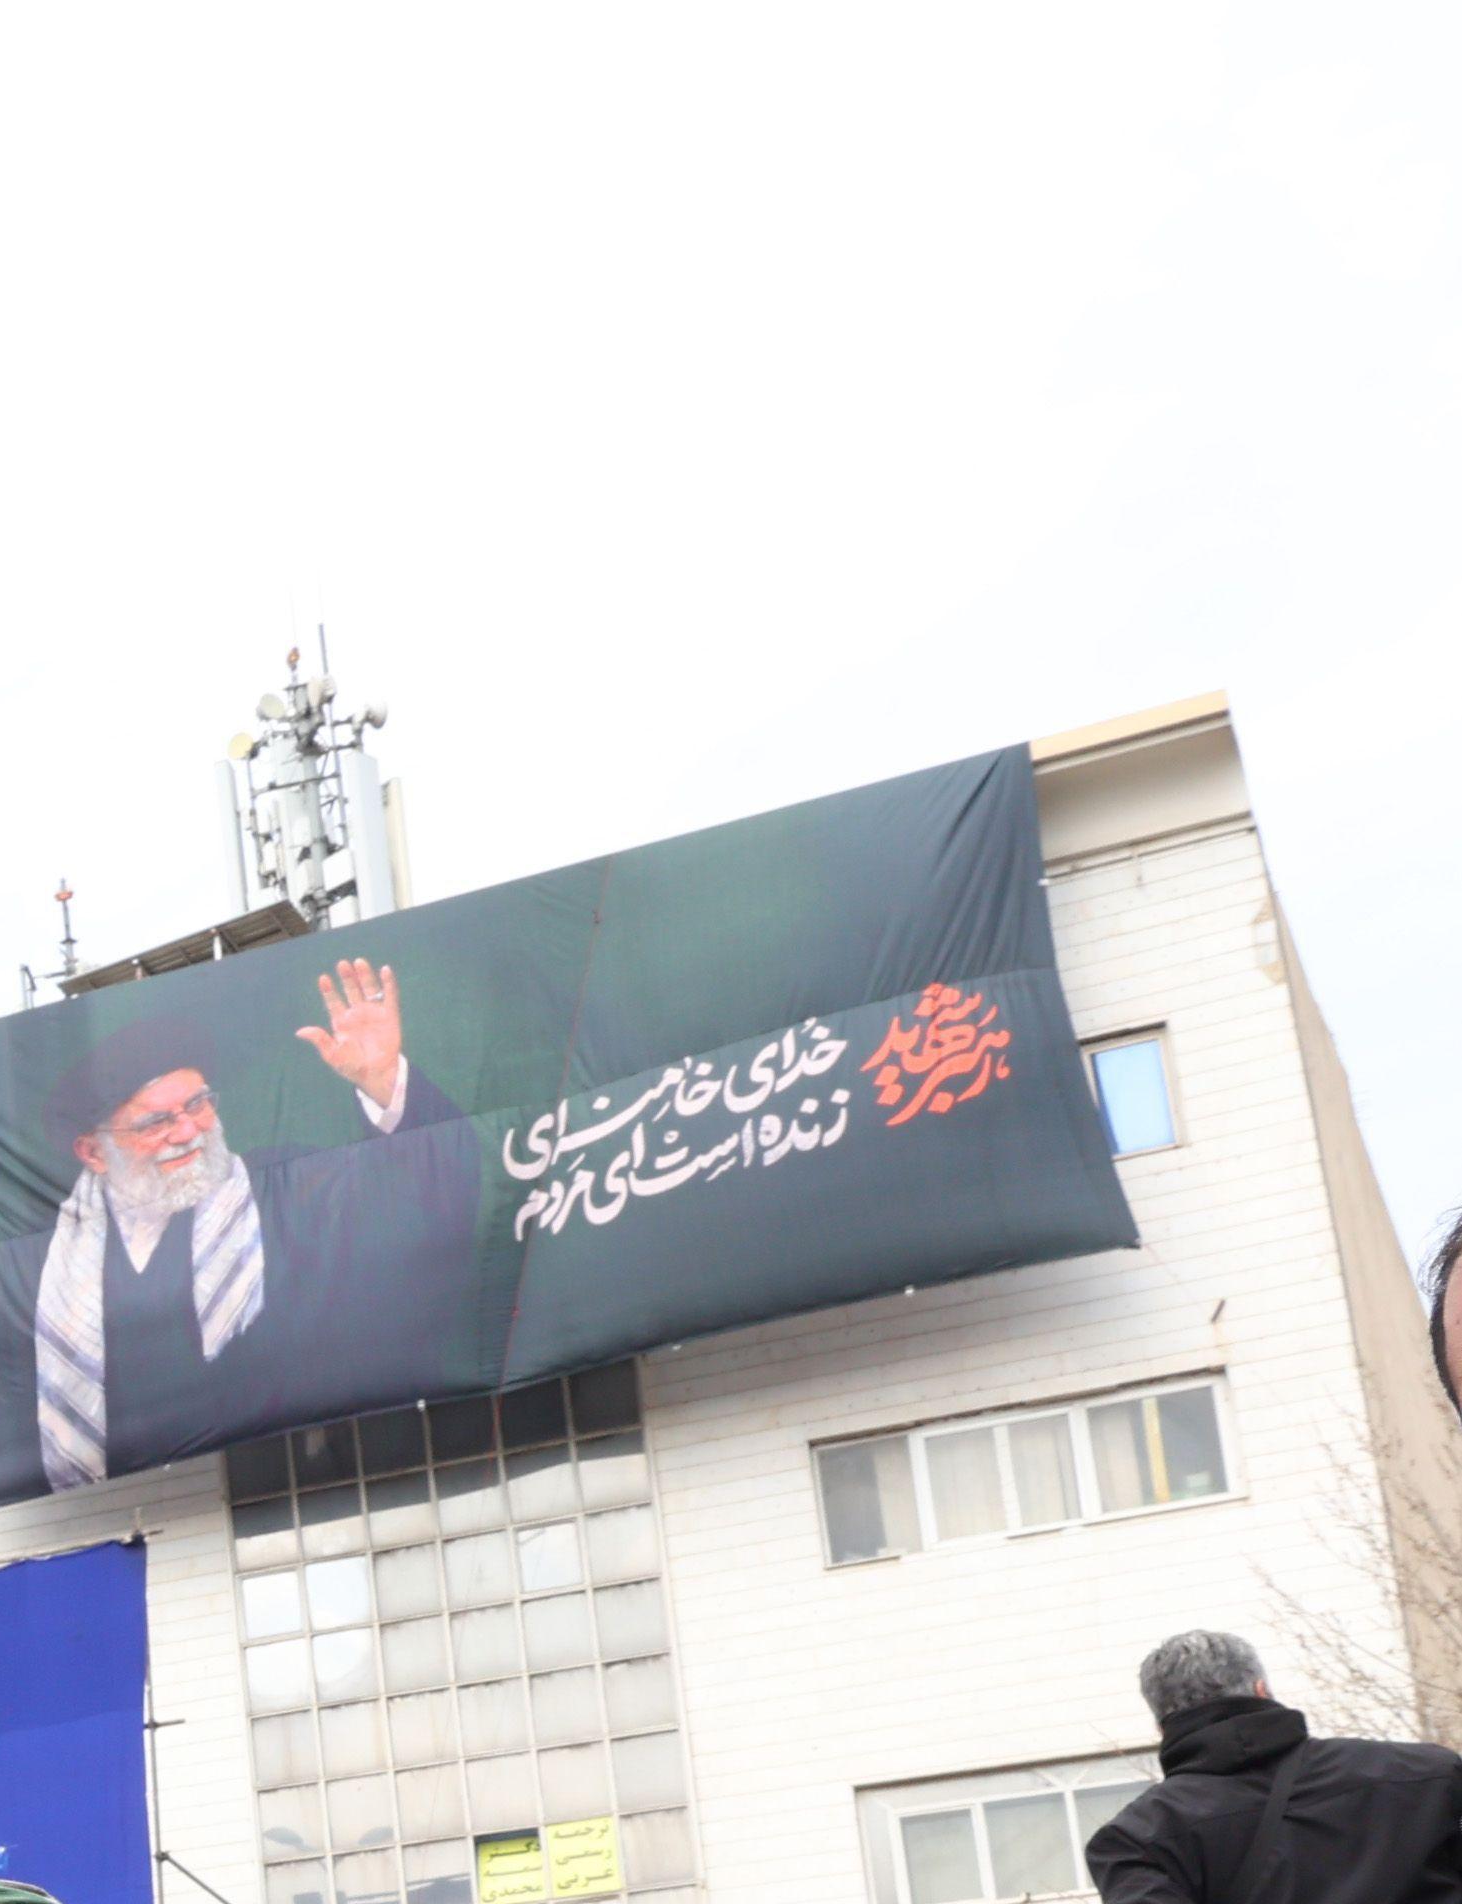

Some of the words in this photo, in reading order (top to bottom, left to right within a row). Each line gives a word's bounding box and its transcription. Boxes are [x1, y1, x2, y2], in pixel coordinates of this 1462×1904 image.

[628, 1117, 755, 1197] است
[763, 1088, 851, 1167] زنده
[583, 1122, 645, 1226] ای
